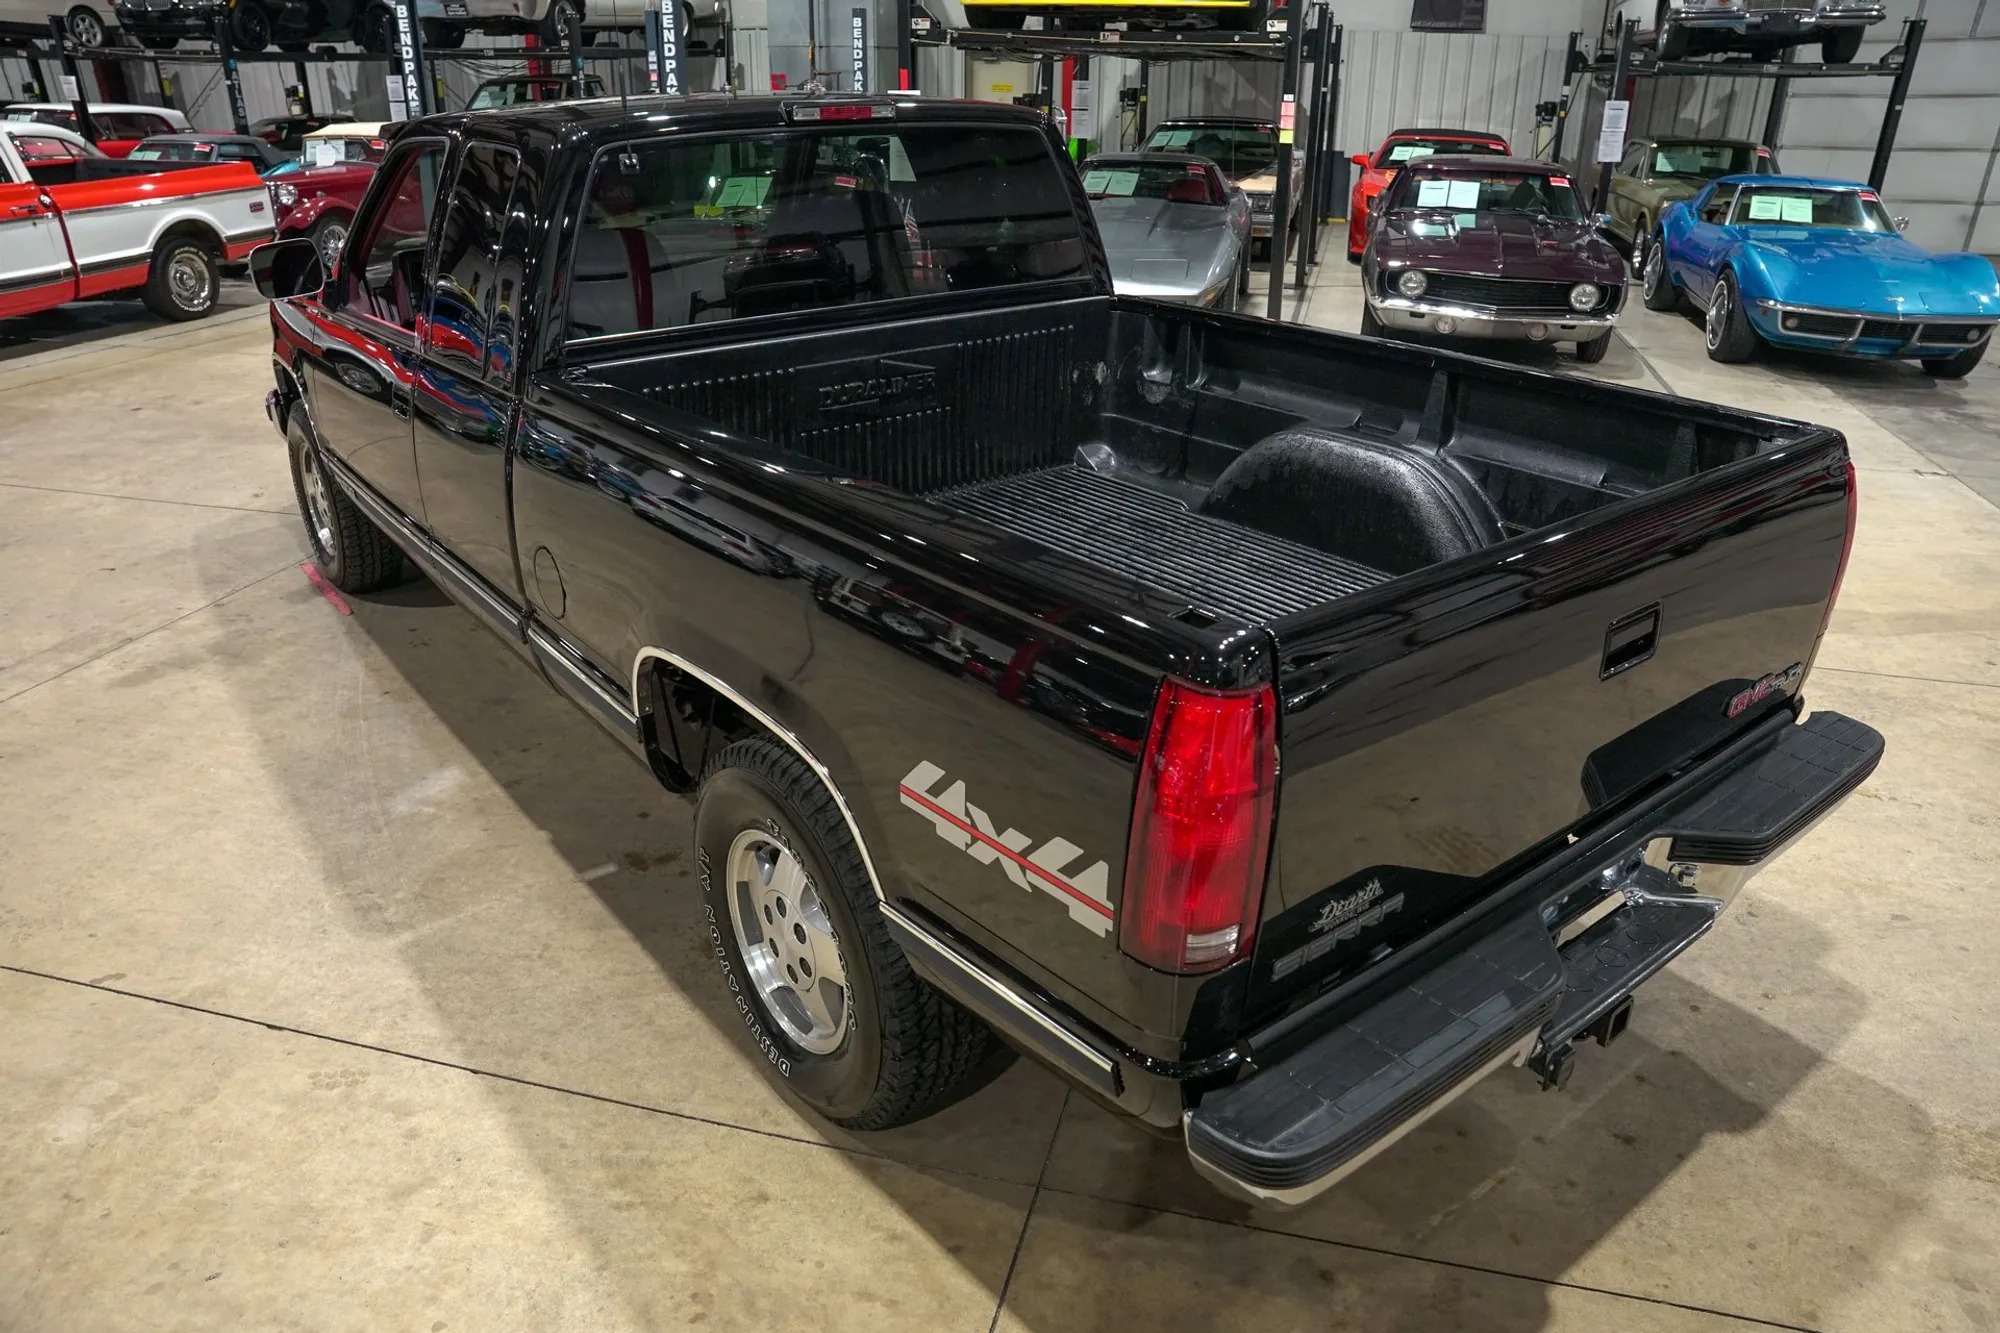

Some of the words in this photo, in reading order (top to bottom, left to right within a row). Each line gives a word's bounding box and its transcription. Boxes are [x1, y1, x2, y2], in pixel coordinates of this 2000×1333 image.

[396, 5, 419, 100] BENDPAK
[661, 0, 680, 95] BENDPAK
[853, 17, 863, 91] BENDPAK
[232, 70, 245, 117] ATLAS
[698, 847, 711, 891] A/T
[1270, 892, 1405, 983] SIERRA
[704, 904, 791, 1078] DESTINATION
